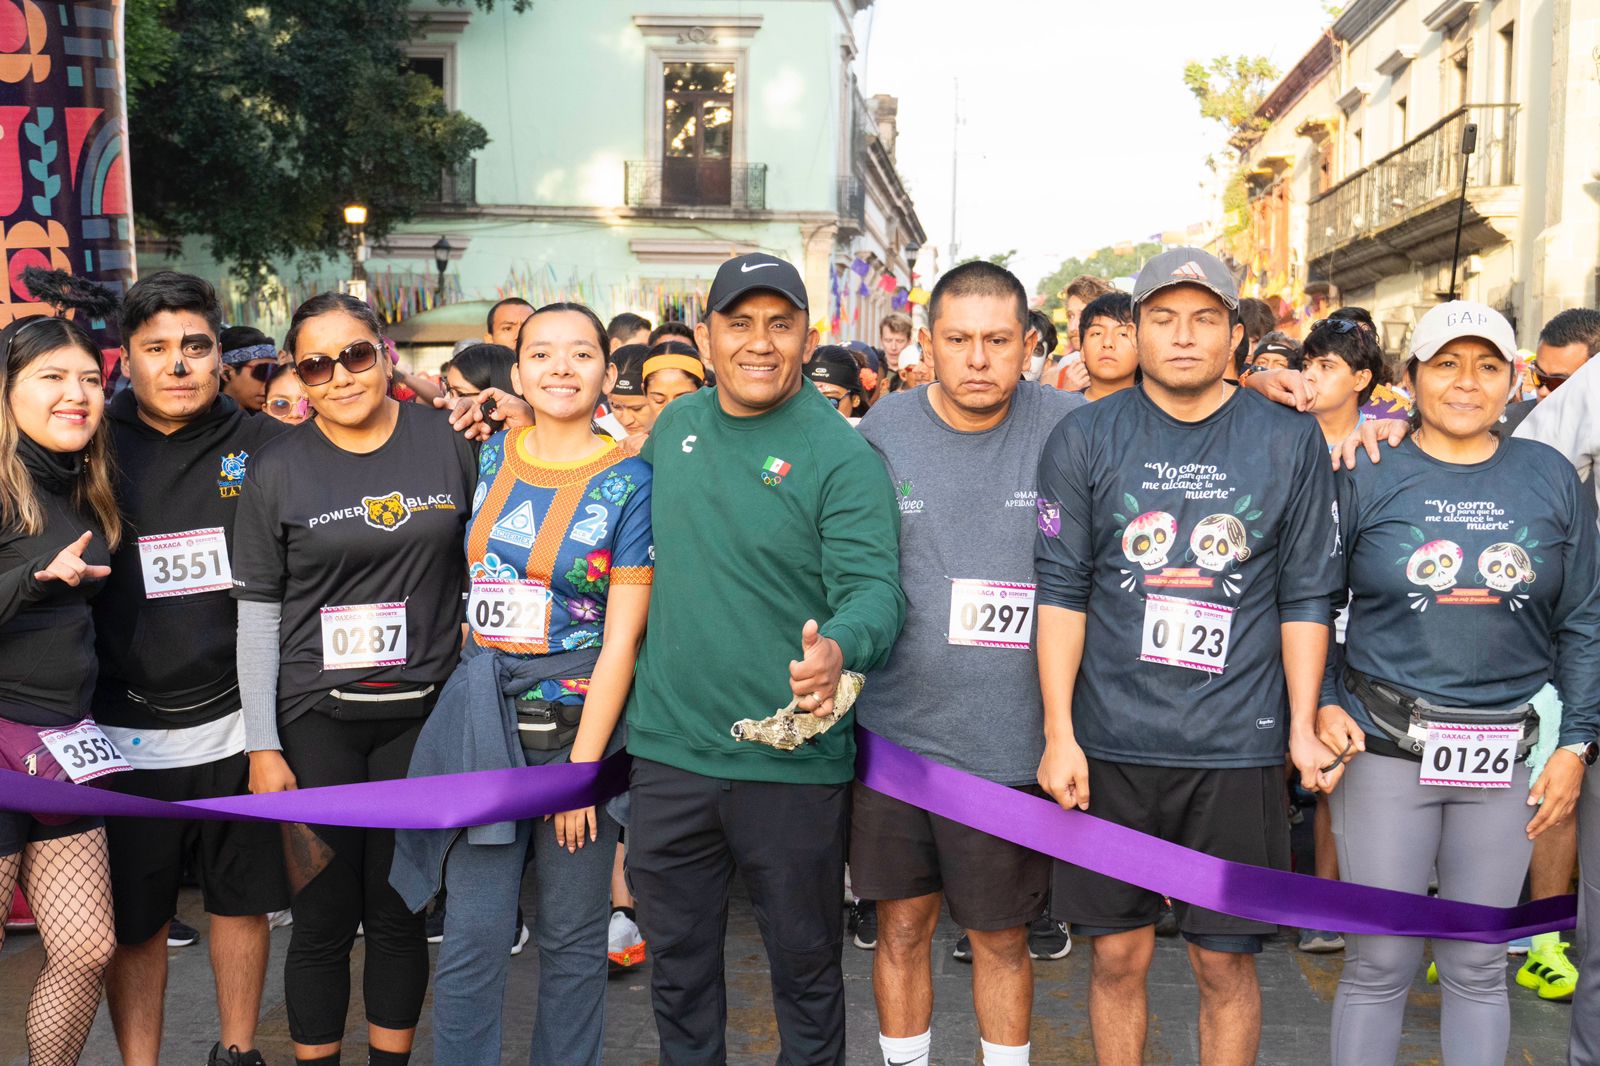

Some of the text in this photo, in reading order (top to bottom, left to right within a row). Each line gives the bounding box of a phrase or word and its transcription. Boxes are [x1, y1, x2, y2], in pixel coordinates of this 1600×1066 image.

[1177, 472, 1227, 482] para que no
[1179, 463, 1217, 474] corro
[1142, 479, 1213, 490] me alcance la
[309, 494, 453, 528] POWER BLACK
[1443, 513, 1484, 522] alcance
[1457, 501, 1495, 509] corro
[153, 541, 181, 550] OAXACA
[152, 549, 222, 584] 3551
[475, 599, 541, 630] 0522
[960, 602, 1031, 634] 0297
[332, 624, 403, 656] 0287
[1152, 618, 1225, 658] 0123
[62, 737, 122, 769] 3552
[1433, 746, 1509, 774] 0126
